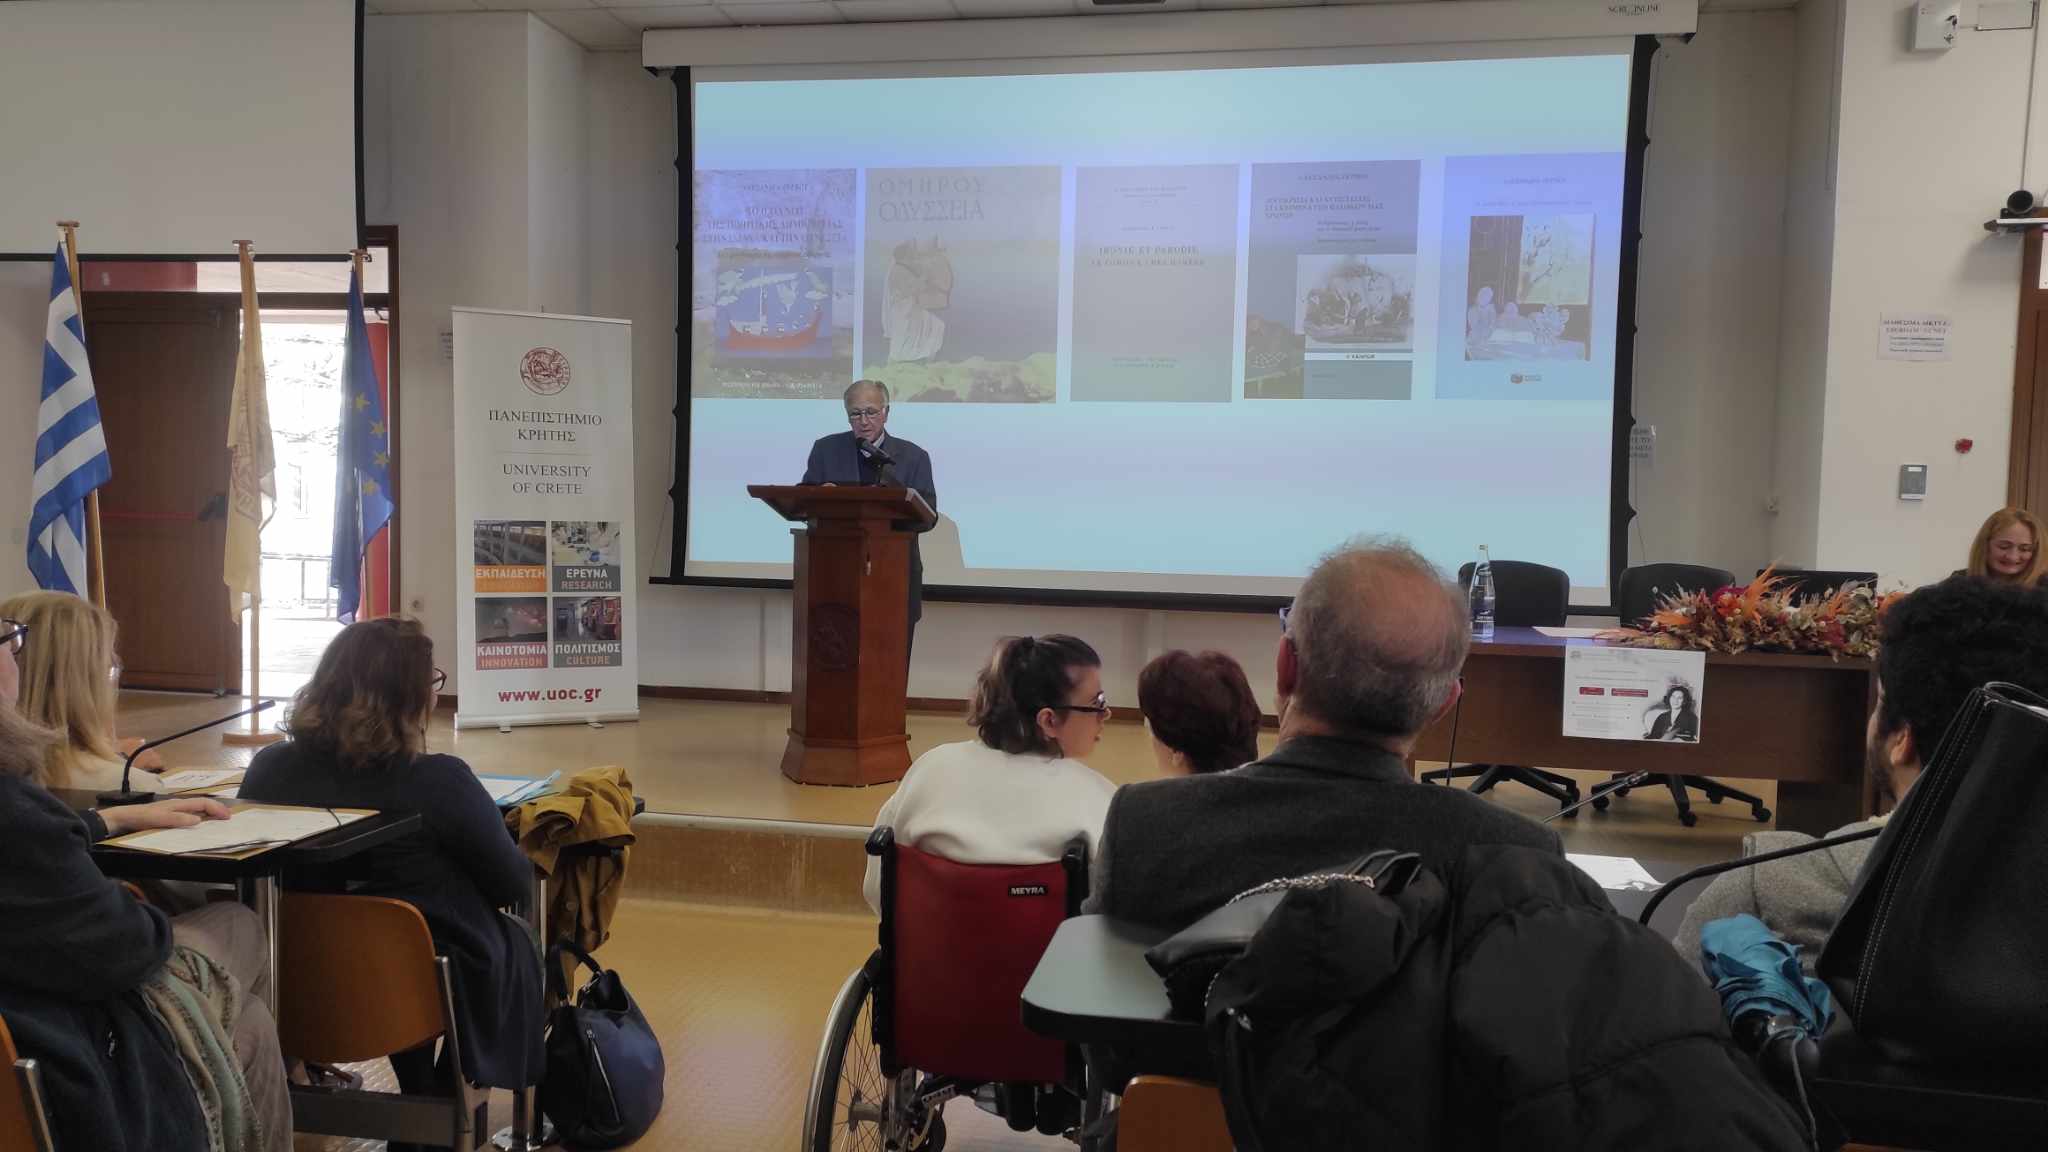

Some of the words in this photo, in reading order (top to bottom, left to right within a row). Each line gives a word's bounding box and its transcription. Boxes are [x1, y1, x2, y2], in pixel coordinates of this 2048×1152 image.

[489, 409, 602, 425] ΠΑΝΕΠΙΣΤΗΜΙΟ
[518, 429, 576, 442] ΚΡΗΤΗΣ
[503, 463, 591, 477] UNIVERSITY
[512, 482, 531, 494] OF
[535, 482, 584, 494] CRETE
[476, 568, 545, 579] ΕΚΠΑΙΔΕΥΣΗ
[566, 568, 608, 578] ΕΡΕΥΝΑ
[561, 580, 612, 590] RESEARCH
[477, 644, 547, 656] ΚΑΙΝΟΤΟΜΙΑ
[555, 643, 621, 654] ΠΟΛΙΤΙΣΜΟΣ
[481, 657, 543, 667] INNOVATION
[566, 655, 610, 665] CULTURE
[498, 686, 602, 702] www.uoc.gr
[1010, 886, 1045, 895] MEYRA
